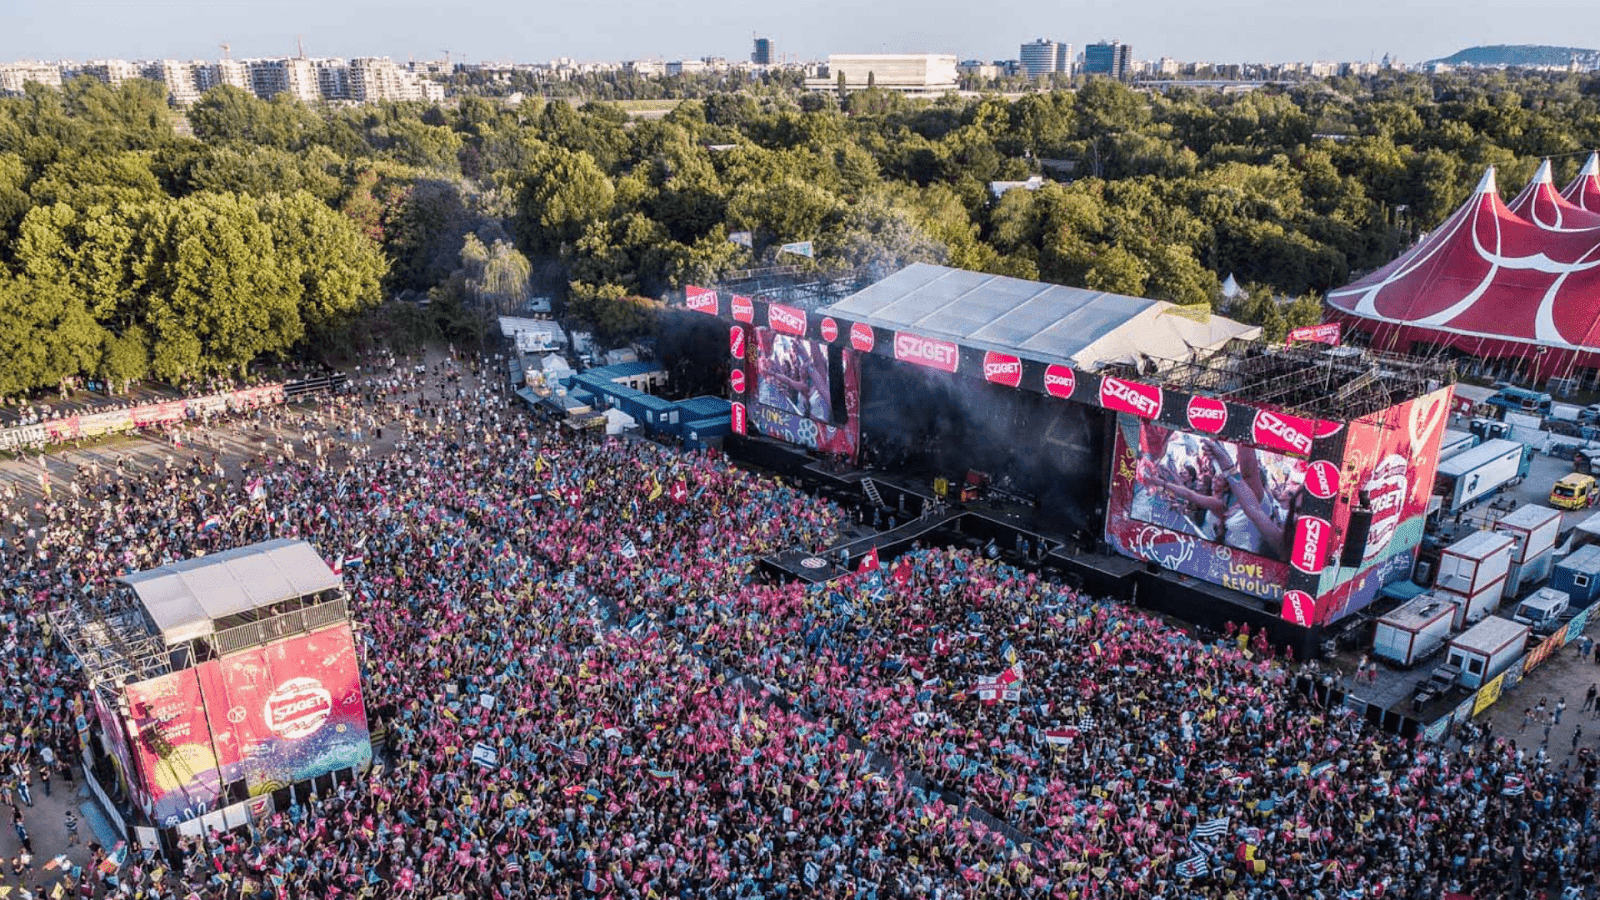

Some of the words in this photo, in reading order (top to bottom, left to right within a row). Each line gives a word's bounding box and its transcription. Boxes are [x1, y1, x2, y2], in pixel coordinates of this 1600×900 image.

[898, 335, 955, 364] SZIGET
[985, 361, 1020, 376] SZIGET
[1045, 374, 1073, 387] SZIGET
[1102, 377, 1159, 415] SZIGET
[1189, 407, 1225, 420] SZIGET
[1256, 411, 1313, 454] SZIGET
[1313, 462, 1331, 496] SZIGET
[1302, 518, 1321, 572] SZIGET
[1228, 562, 1264, 578] LOVE
[1222, 573, 1287, 598] REVOLUT
[1288, 591, 1306, 627] SZIGET
[273, 696, 325, 721] SZIGET
